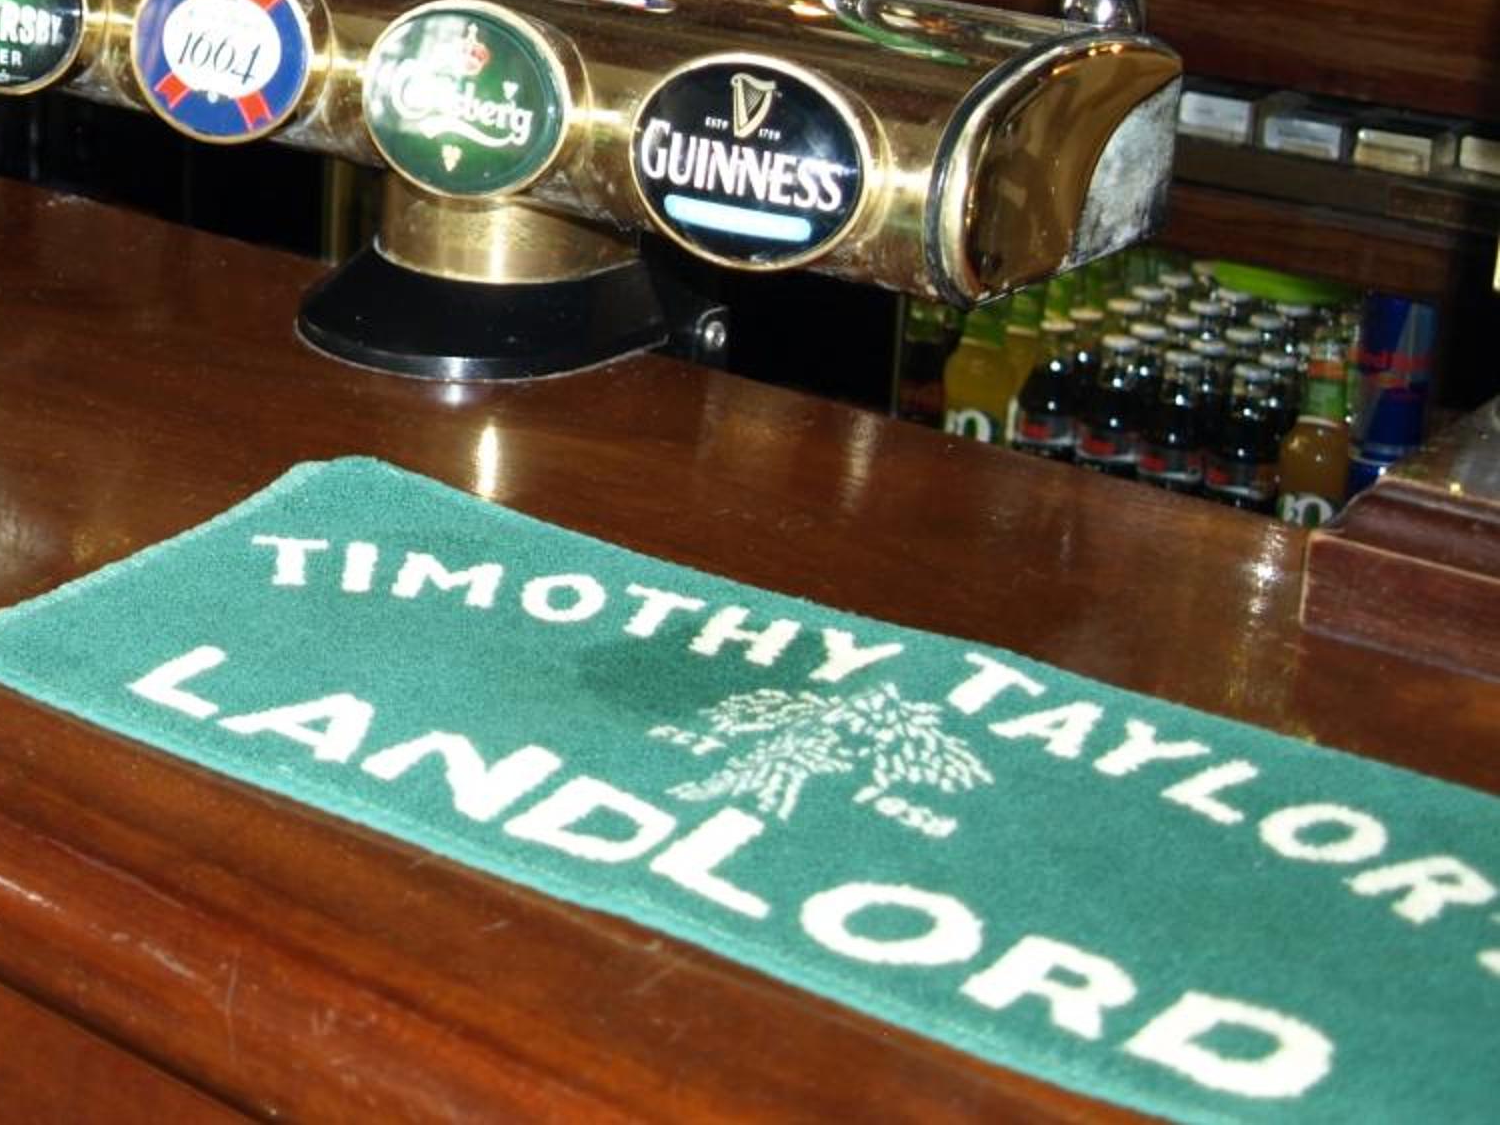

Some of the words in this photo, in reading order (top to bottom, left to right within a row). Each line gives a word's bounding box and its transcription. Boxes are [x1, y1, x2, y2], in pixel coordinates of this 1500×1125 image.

[177, 30, 262, 87] 1664
[640, 117, 844, 213] GUINNESS
[127, 644, 1336, 1099] LANDLORD
[251, 534, 902, 684] TIMOTHY
[946, 653, 1500, 978] TAYLOR
